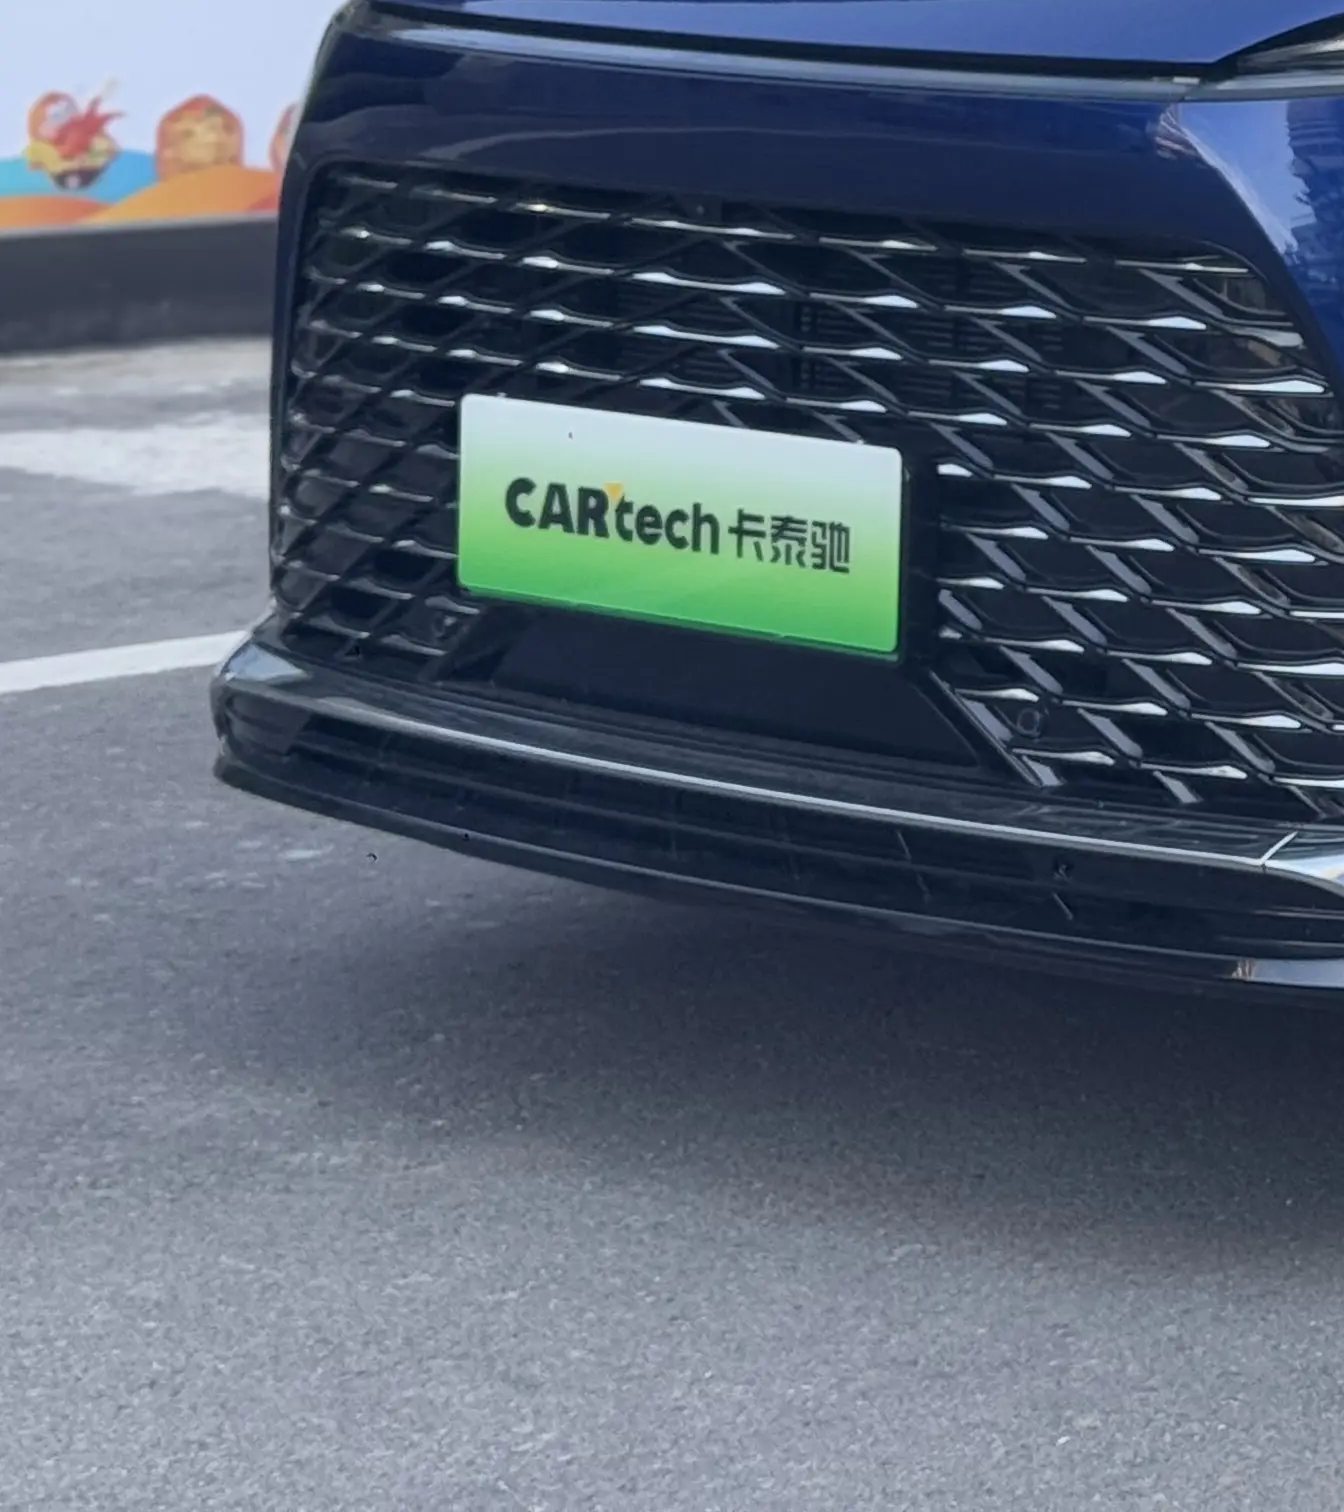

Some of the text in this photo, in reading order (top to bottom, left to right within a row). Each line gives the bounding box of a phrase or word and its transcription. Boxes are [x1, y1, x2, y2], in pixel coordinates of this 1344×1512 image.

[504, 476, 852, 575] CARtech 卡泰驰
